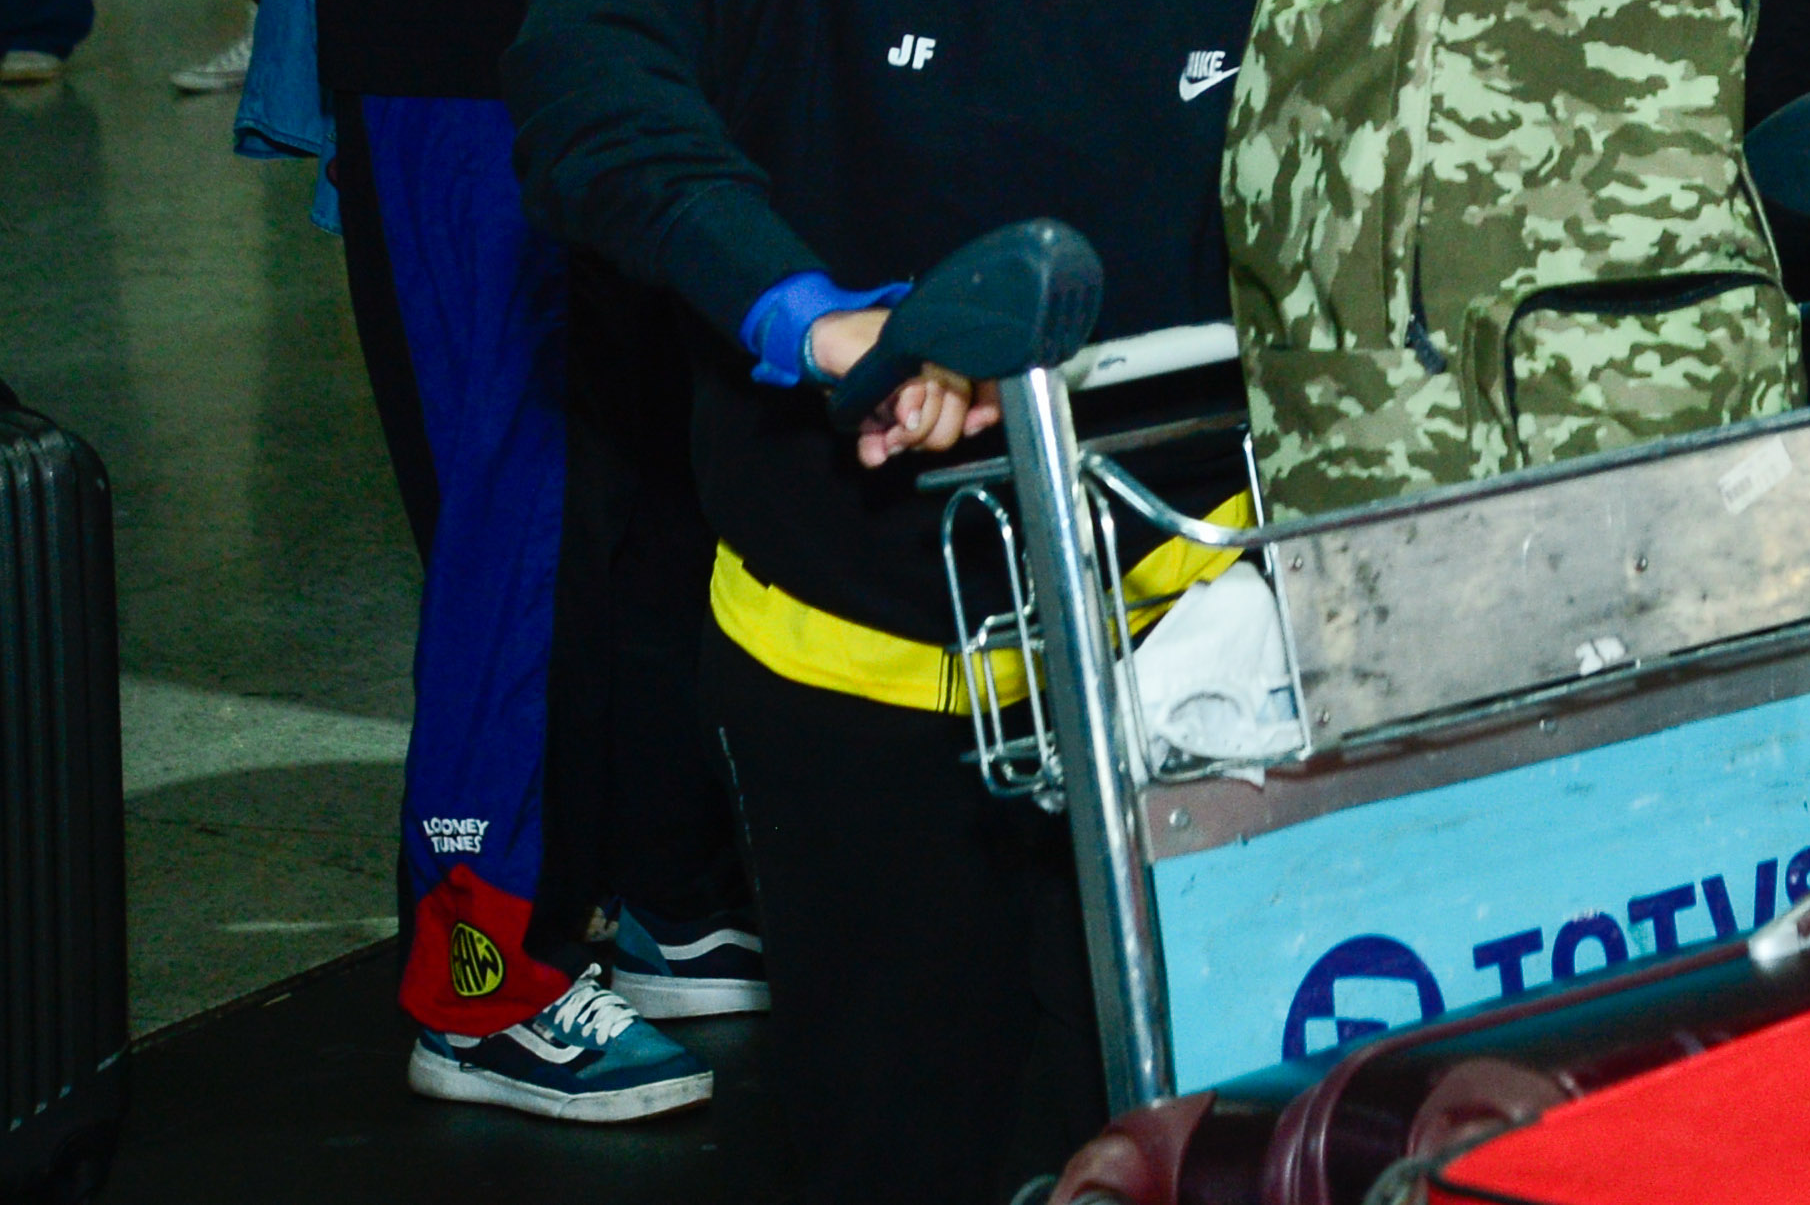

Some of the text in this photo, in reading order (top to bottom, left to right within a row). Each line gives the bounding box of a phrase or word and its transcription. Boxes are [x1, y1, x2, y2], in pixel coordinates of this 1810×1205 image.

[887, 33, 936, 70] JF
[1186, 50, 1226, 79] NIKE
[423, 816, 490, 838] LOONEY
[430, 835, 483, 855] TUNES
